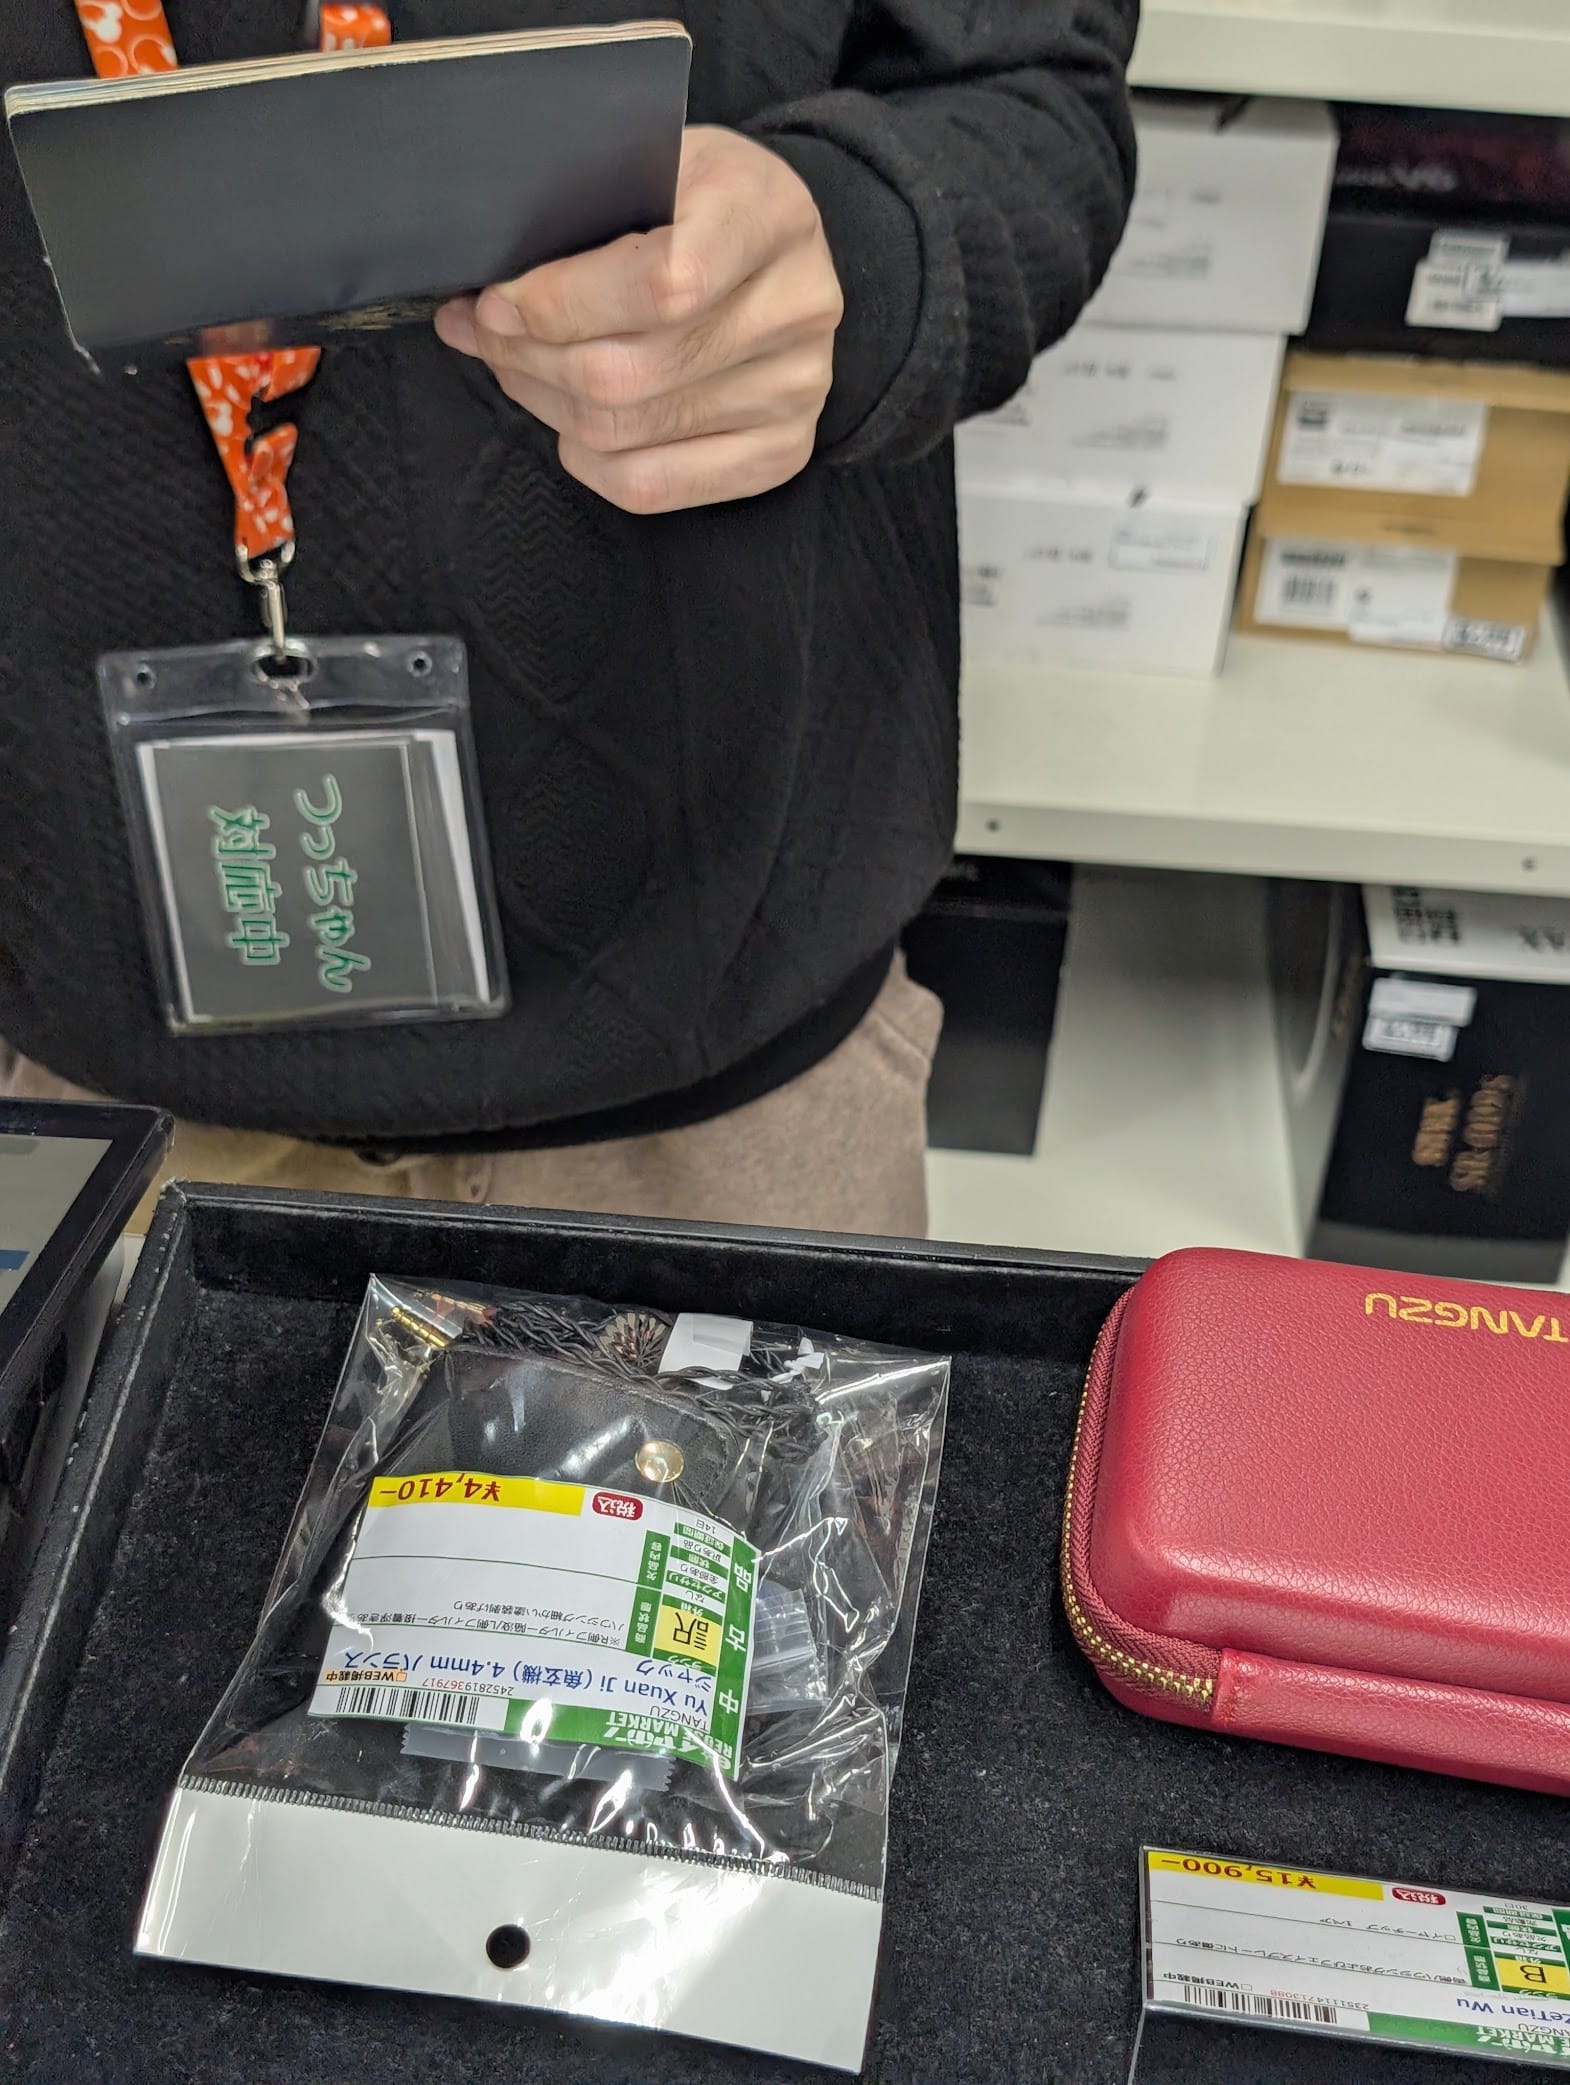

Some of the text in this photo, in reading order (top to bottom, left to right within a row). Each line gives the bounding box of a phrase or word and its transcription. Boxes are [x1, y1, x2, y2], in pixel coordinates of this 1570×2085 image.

[208, 805, 290, 965] 対応中
[294, 774, 371, 992] つっちゃん
[1365, 1292, 1569, 1342] TANGZU
[596, 1496, 636, 1519] 税込
[695, 1518, 717, 1535] 14日
[646, 1541, 662, 1581] 欠品内容
[683, 1539, 722, 1563] 訳あり品
[688, 1553, 710, 1568] 状態
[669, 1572, 723, 1599] アクセサリ
[680, 1564, 719, 1585] 全部あり
[685, 1590, 705, 1603] なし
[351, 1612, 621, 1646] ※R側フィルター陥没/L側フィルター接着浮きあ
[634, 1601, 652, 1644] 商品状態
[672, 1612, 709, 1651] 訳
[718, 1562, 752, 1714] 中古品
[667, 1654, 702, 1670] ランク
[325, 1669, 394, 1682] WEB掲載中
[343, 1651, 708, 1716] Yu Xuan Ji (魚玄機) 4.4mm バランス
[422, 1678, 514, 1696] 2452819367917
[635, 1659, 712, 1693] ジャック
[606, 1712, 679, 1737] MARKET
[649, 1705, 709, 1731] TANGZU
[1519, 1964, 1547, 1983] B
[1270, 1989, 1369, 2010] 2351114713088
[1456, 1998, 1494, 2014] Wu
[1476, 2025, 1554, 2045] MARKET
